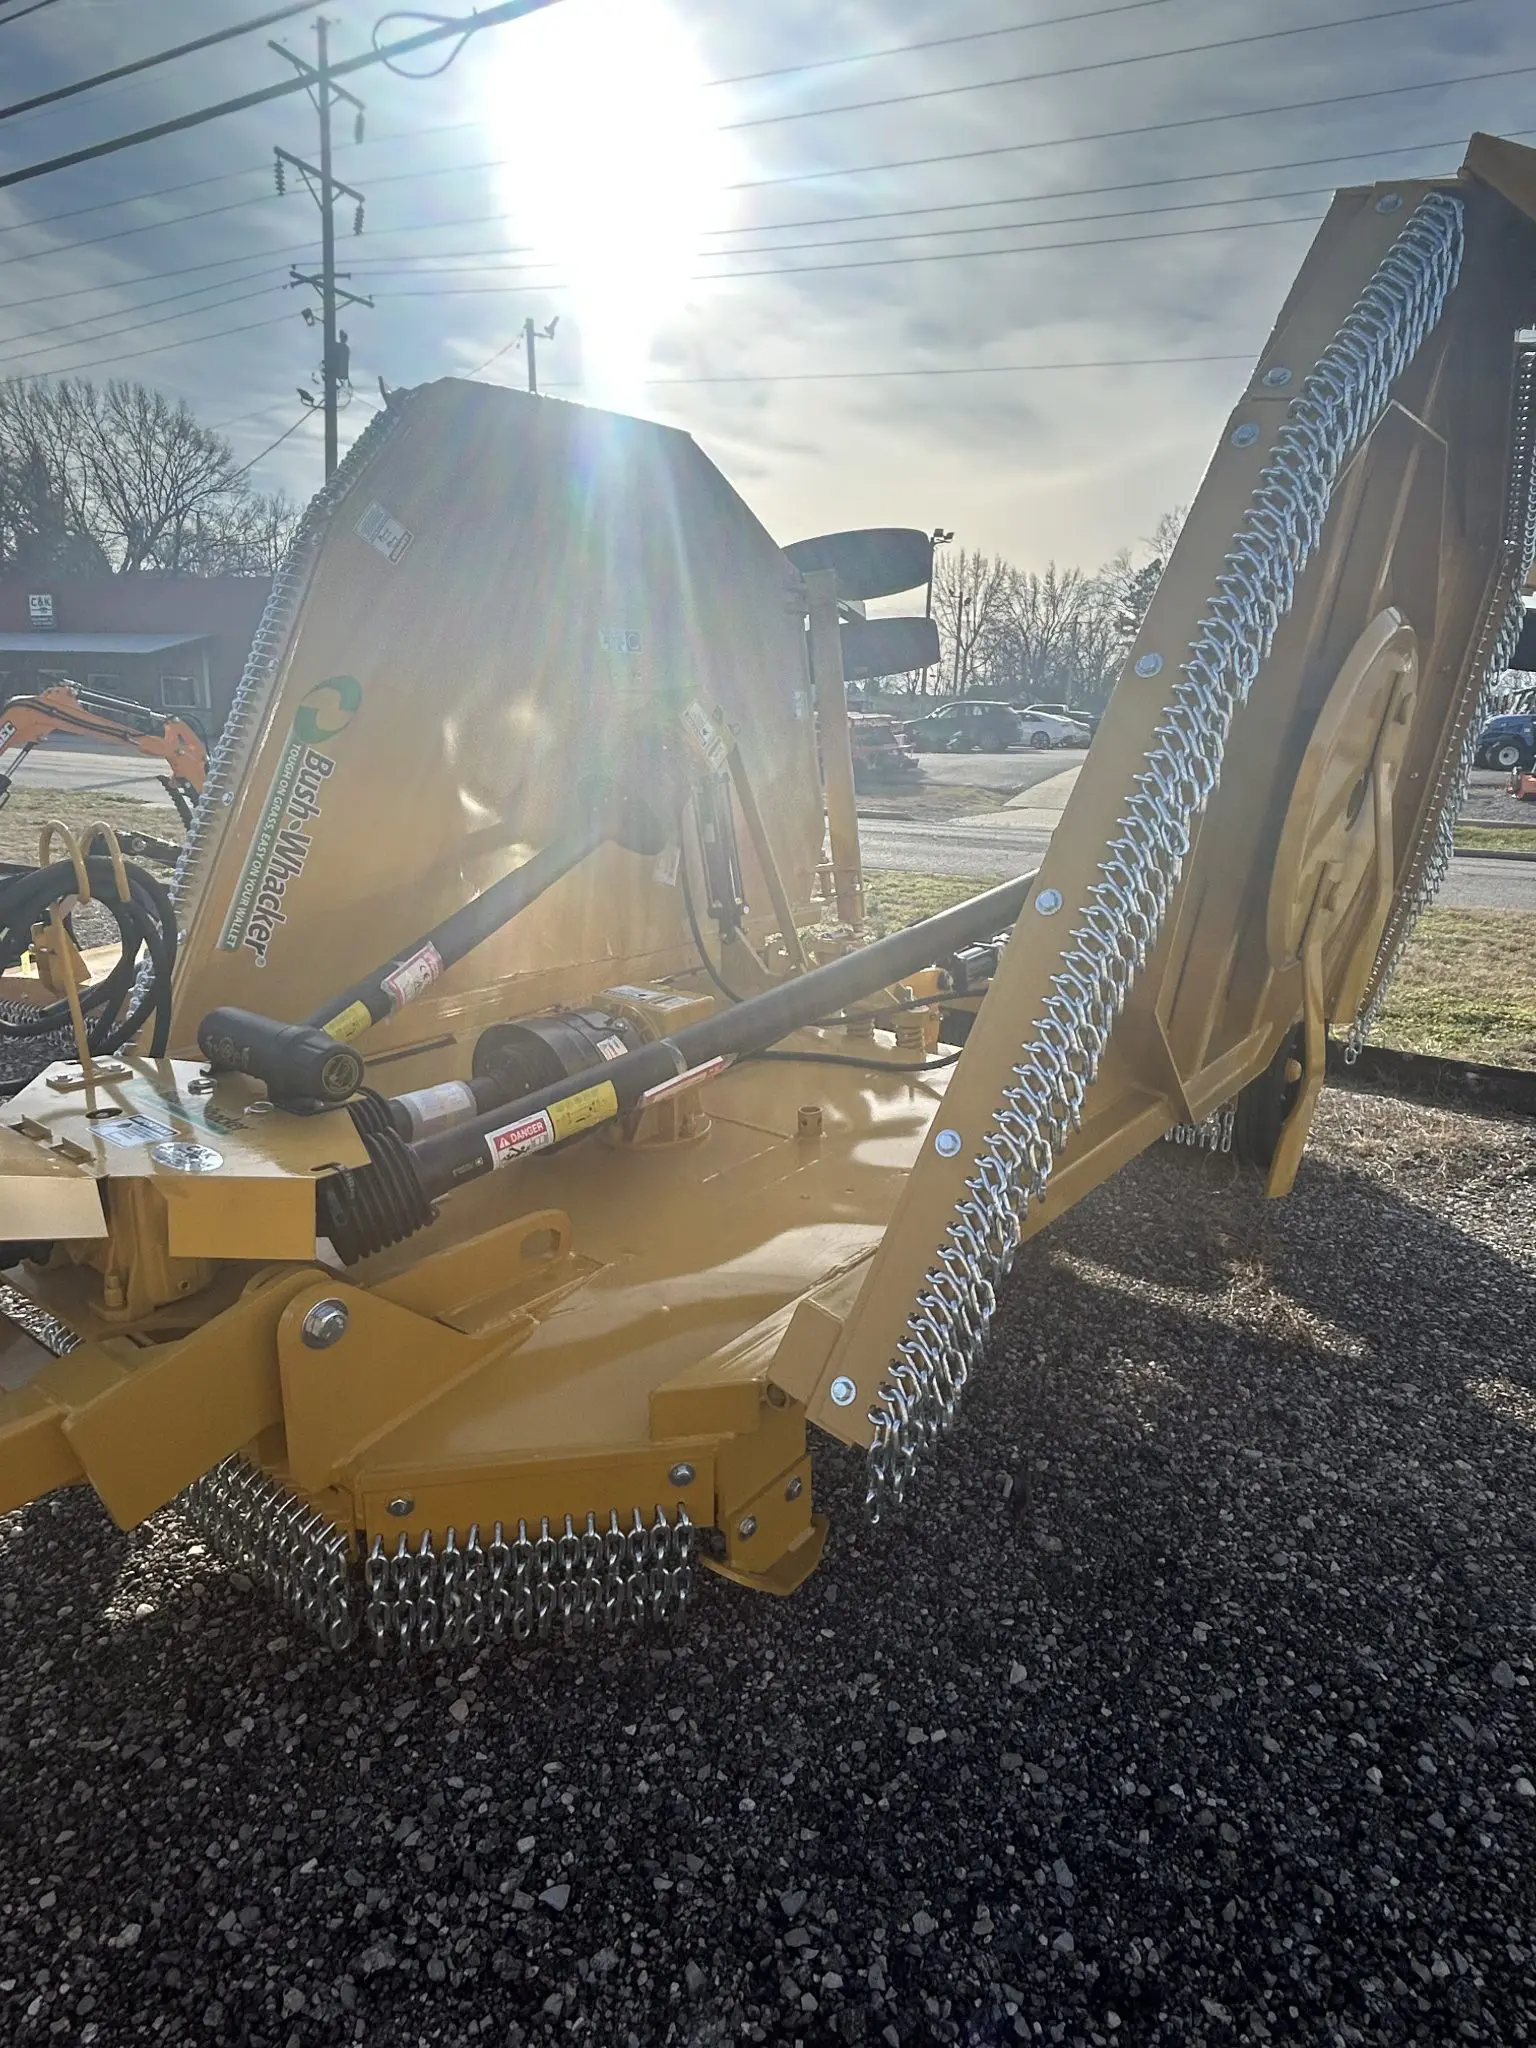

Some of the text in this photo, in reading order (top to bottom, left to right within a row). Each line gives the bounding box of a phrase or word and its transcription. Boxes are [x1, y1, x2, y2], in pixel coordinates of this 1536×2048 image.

[226, 743, 301, 948] TOUGH ON GRASS, EASY ON YOUR WALLET
[510, 1121, 545, 1144] DANGER
